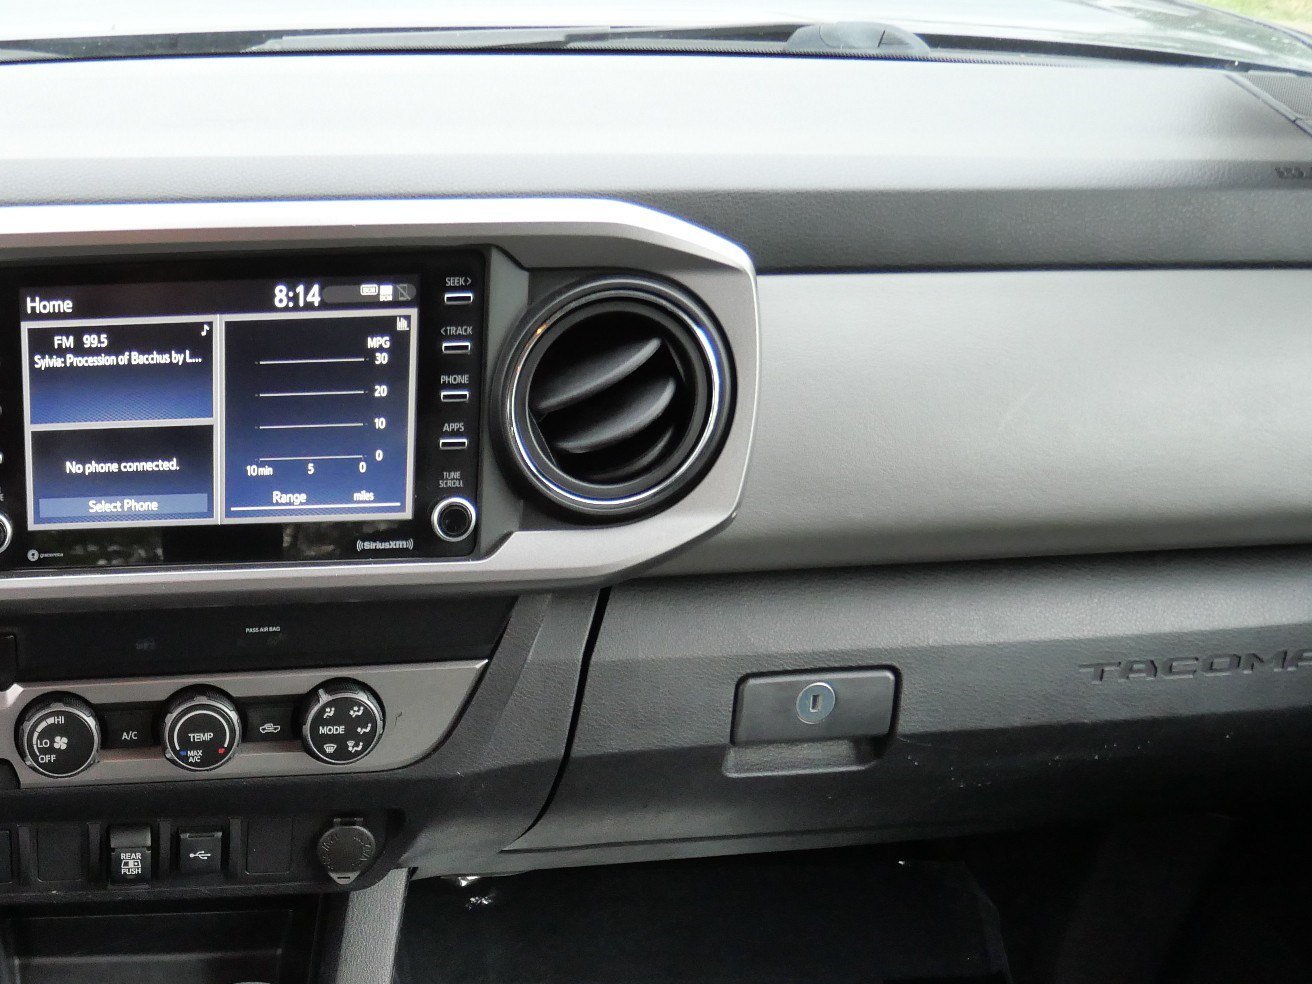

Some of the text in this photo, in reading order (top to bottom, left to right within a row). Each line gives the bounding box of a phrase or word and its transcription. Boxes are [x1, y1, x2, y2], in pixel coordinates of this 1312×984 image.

[274, 284, 321, 308] 8:14
[26, 296, 73, 314] Home
[54, 334, 108, 349] FM 99.5
[367, 336, 390, 349] MPG
[34, 354, 65, 370] Sylvia:
[66, 353, 117, 367] Procession
[118, 352, 130, 365] of
[131, 351, 170, 365] Bacchus
[171, 351, 184, 366] by
[374, 352, 388, 364] 30
[440, 374, 469, 384] PHONE
[374, 385, 388, 397] 20
[374, 418, 386, 429] 10
[443, 422, 465, 432] APPS
[375, 450, 383, 461] 0
[65, 457, 180, 476] No phone connected.
[246, 465, 273, 476] 10 min
[307, 463, 315, 475] 5
[359, 462, 367, 473] 0
[443, 471, 461, 480] TUNE
[439, 479, 464, 488] SCROLL
[272, 490, 307, 505] Range
[353, 490, 375, 502] miles
[88, 499, 159, 513] Select Phone
[54, 716, 65, 724] HI
[319, 725, 345, 735] MODE
[122, 731, 138, 741] A/C
[188, 733, 214, 742] TEMP
[38, 739, 50, 748] LO
[38, 755, 57, 763] OFF
[120, 852, 142, 860] REAR
[121, 867, 142, 875] PUSH
